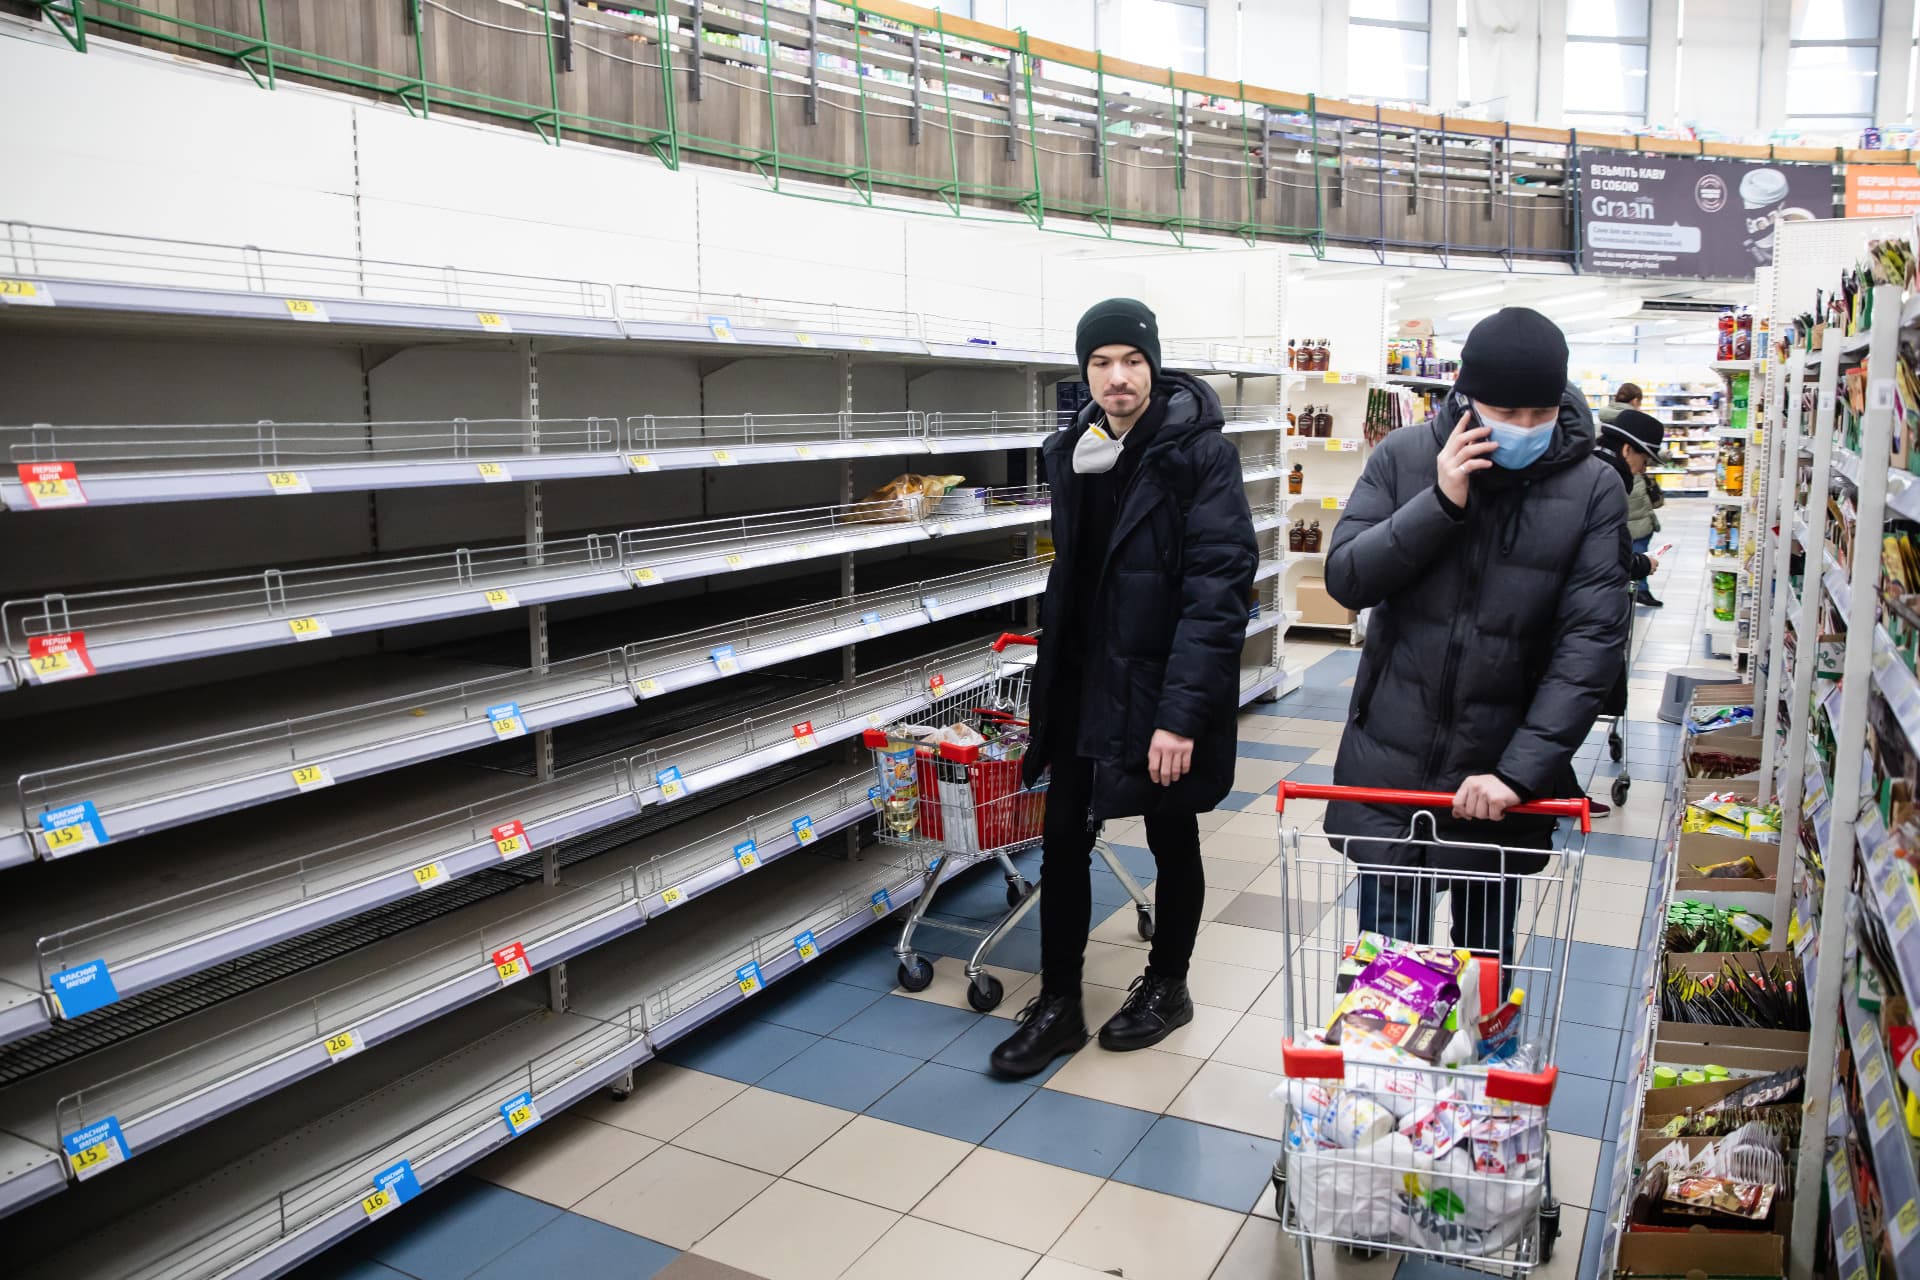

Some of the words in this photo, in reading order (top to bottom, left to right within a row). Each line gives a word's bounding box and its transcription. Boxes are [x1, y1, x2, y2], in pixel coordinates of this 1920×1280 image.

[1602, 179, 1639, 192] СОБОЮ
[1592, 196, 1655, 219] Graan
[3, 282, 22, 293] 27
[39, 481, 60, 494] 22
[295, 619, 310, 631] 37
[42, 636, 72, 647] ПЕРША
[40, 656, 60, 670] 22
[298, 768, 313, 780] 37
[47, 805, 85, 822] ВЛАСНИЙ
[54, 814, 84, 828] ІМПОРТ
[52, 828, 73, 844] 15
[501, 839, 514, 852] 22
[417, 867, 431, 880] 27
[664, 891, 677, 902] 26
[60, 965, 98, 984] ВЛАСНИЙ
[502, 963, 514, 976] 22
[66, 974, 96, 990] ІМПОРТ
[330, 1037, 347, 1051] 26
[512, 1109, 525, 1122] 15
[73, 1122, 109, 1144] ВЛАСНИЙ
[79, 1131, 108, 1149] ІМПОРТ
[76, 1149, 98, 1167] 15
[368, 1194, 383, 1210] 16
